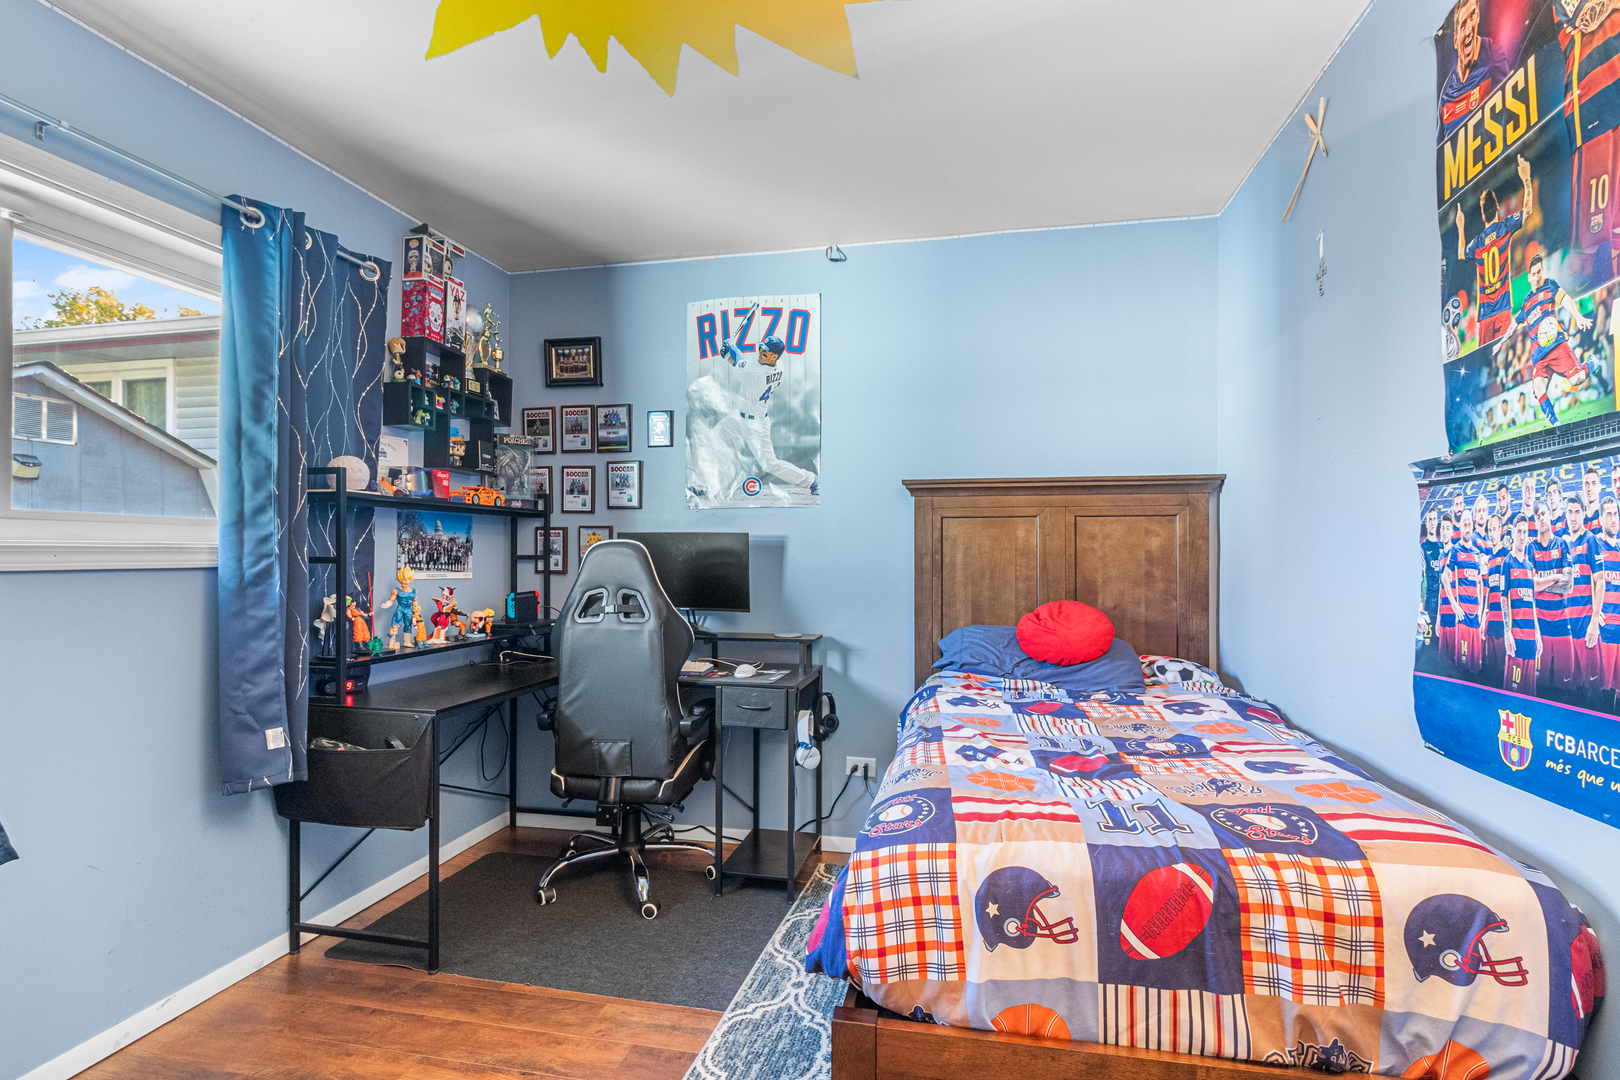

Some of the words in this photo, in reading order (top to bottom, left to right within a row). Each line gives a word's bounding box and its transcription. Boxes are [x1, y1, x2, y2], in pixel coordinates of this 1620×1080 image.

[1443, 54, 1538, 201] MESSI
[1589, 174, 1609, 213] 10
[1482, 246, 1500, 285] 10
[450, 285, 465, 302] YAZ
[696, 307, 811, 359] RIZZO
[1512, 665, 1521, 684] 10
[1546, 729, 1620, 770] FCBARCE
[1545, 759, 1572, 775] més
[1577, 769, 1604, 789] que
[868, 819, 922, 838] Stars
[1085, 798, 1194, 836] 11
